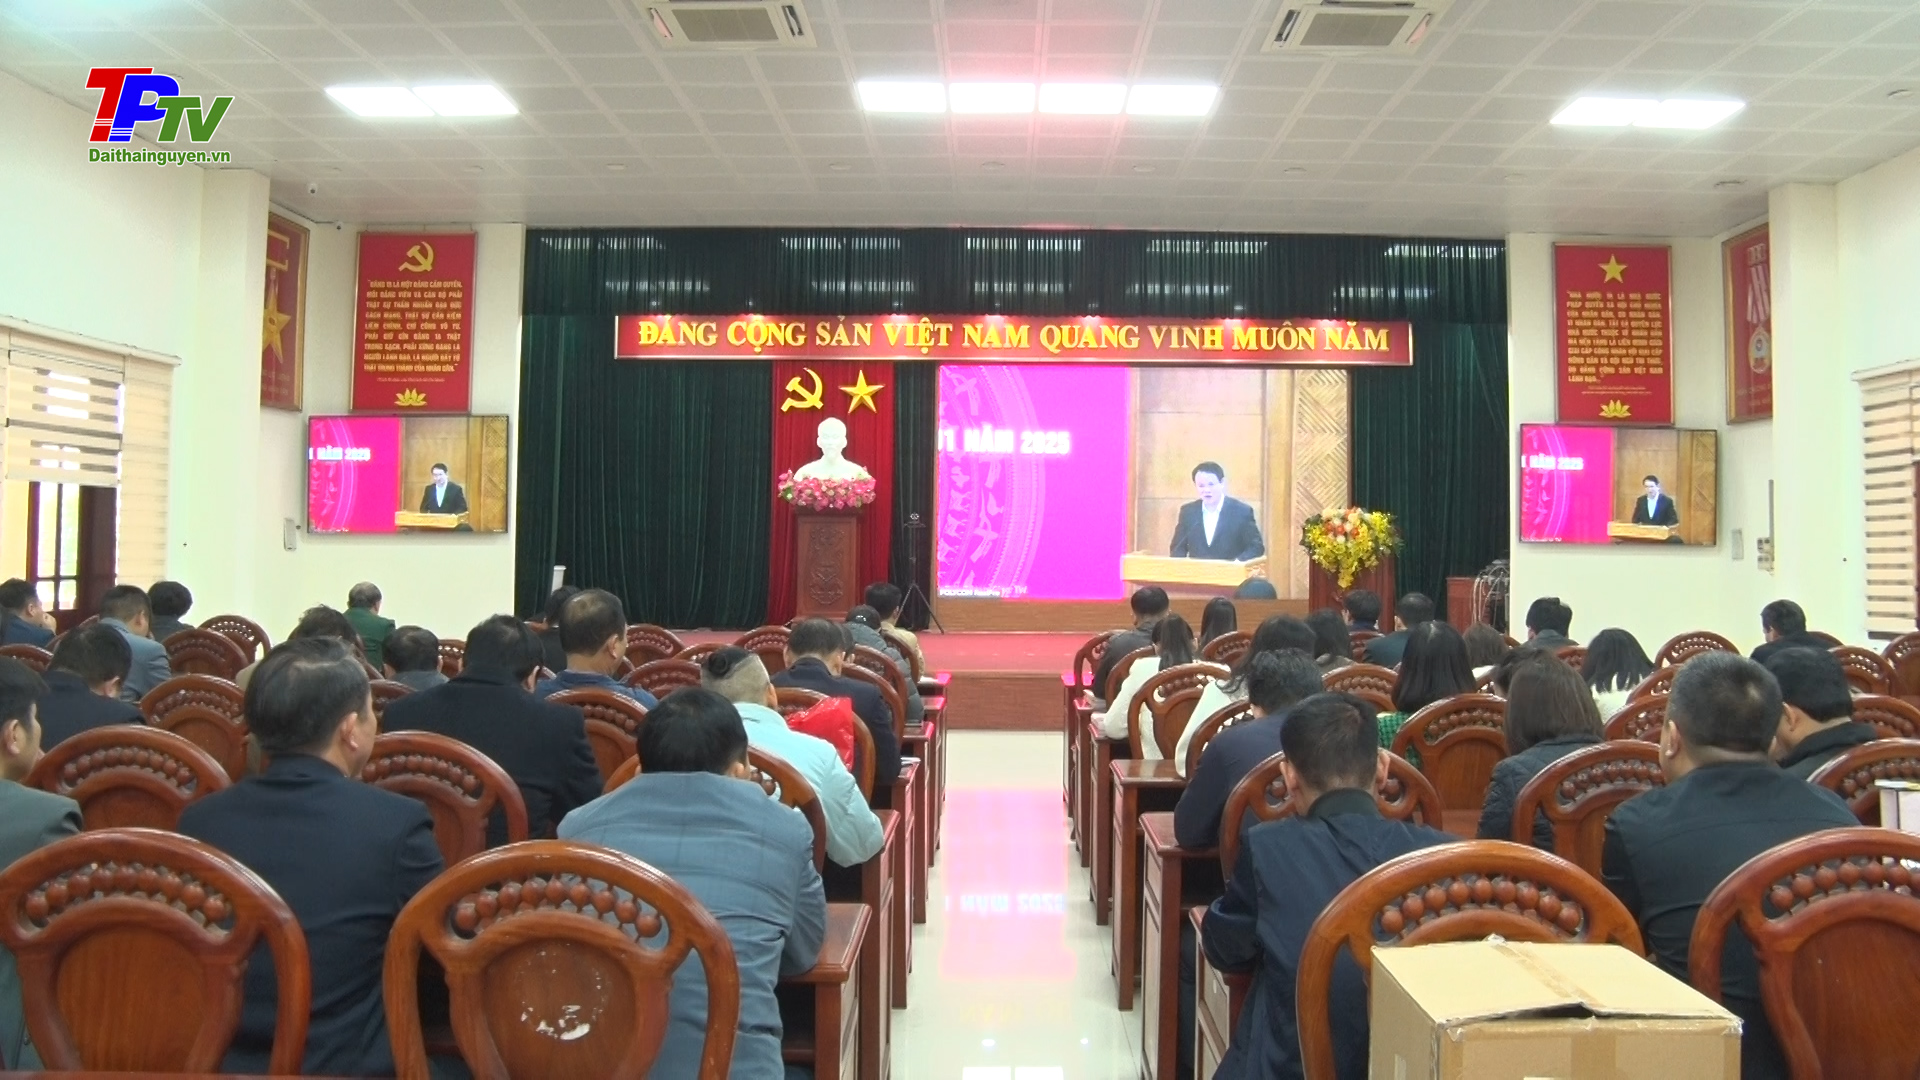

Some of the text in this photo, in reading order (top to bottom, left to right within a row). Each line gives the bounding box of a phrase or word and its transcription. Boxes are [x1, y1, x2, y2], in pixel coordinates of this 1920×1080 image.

[638, 315, 1390, 354] ĐẢNG CỘNG SẢN VIỆT NAM QUANG VINH MUÔN NĂM
[963, 421, 1014, 453] NĂM
[1020, 430, 1071, 455] 2025
